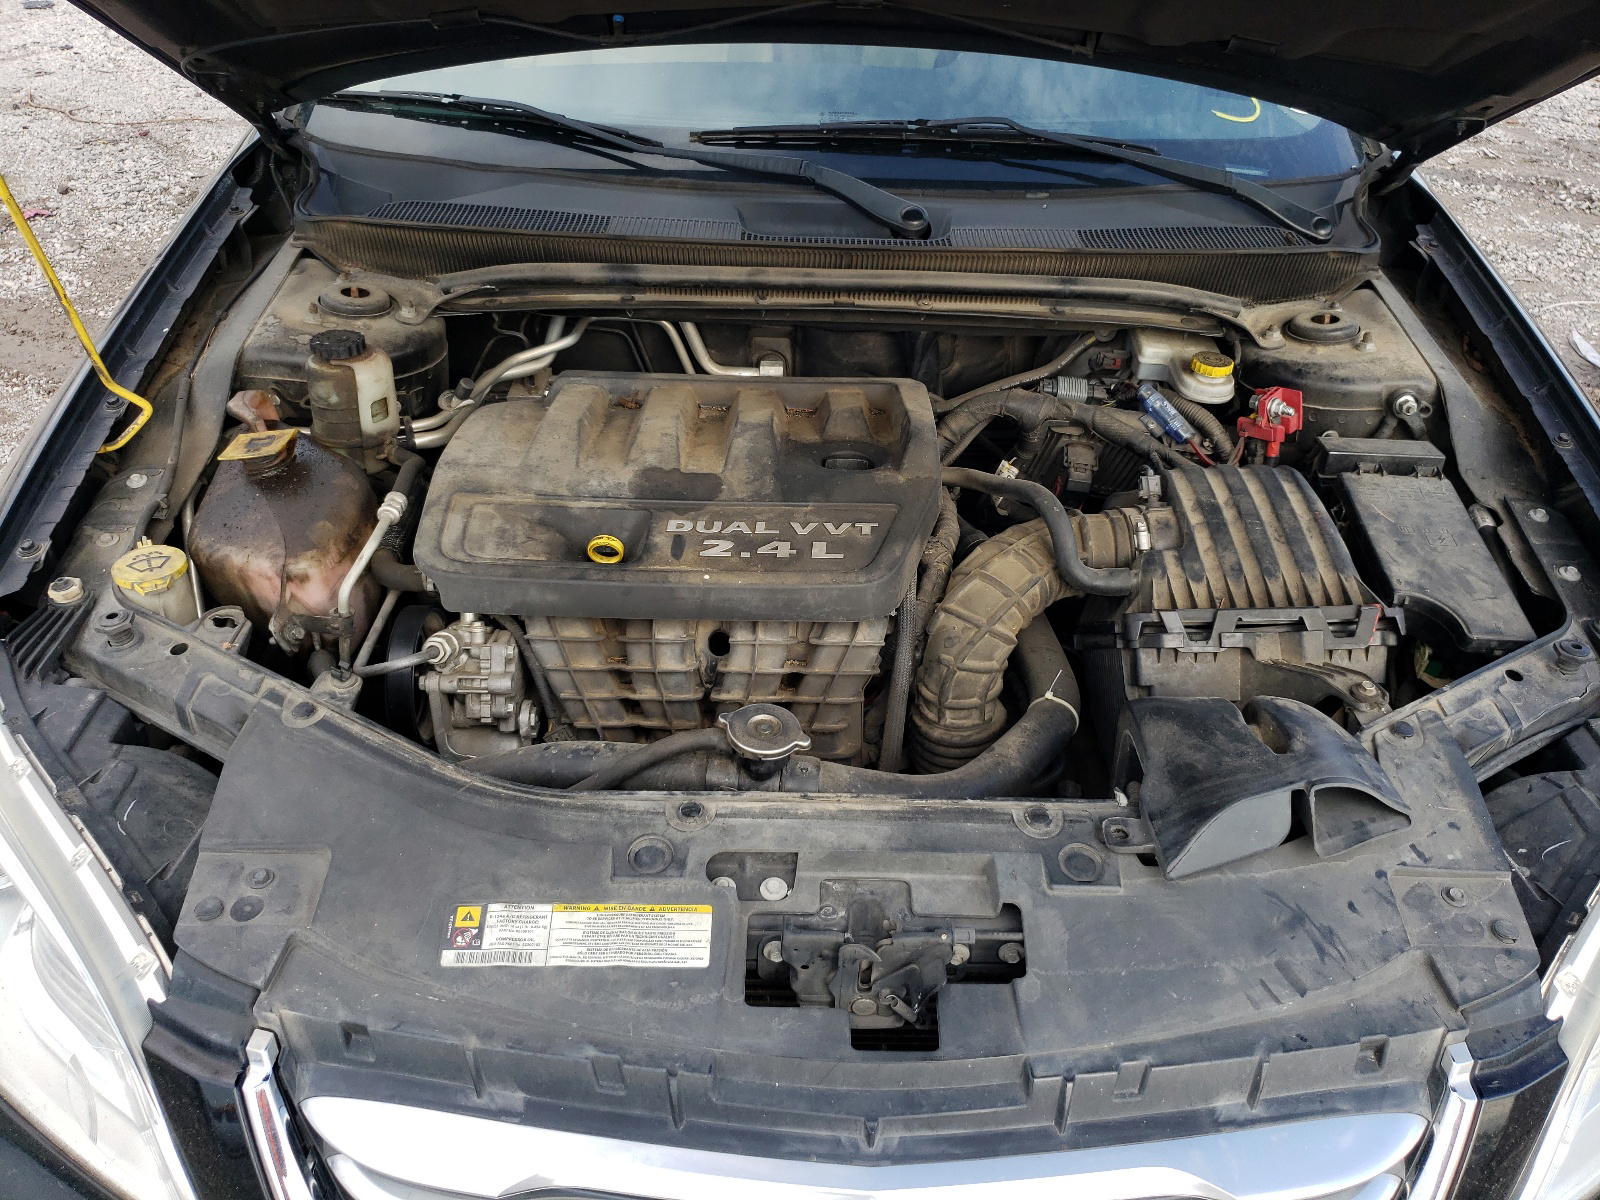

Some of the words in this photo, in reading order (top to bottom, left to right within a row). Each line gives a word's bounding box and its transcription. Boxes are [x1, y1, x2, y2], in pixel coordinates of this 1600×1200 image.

[666, 519, 780, 534] DUAL
[789, 522, 879, 535] VVT
[699, 539, 797, 558] 2.4
[811, 541, 845, 559] L
